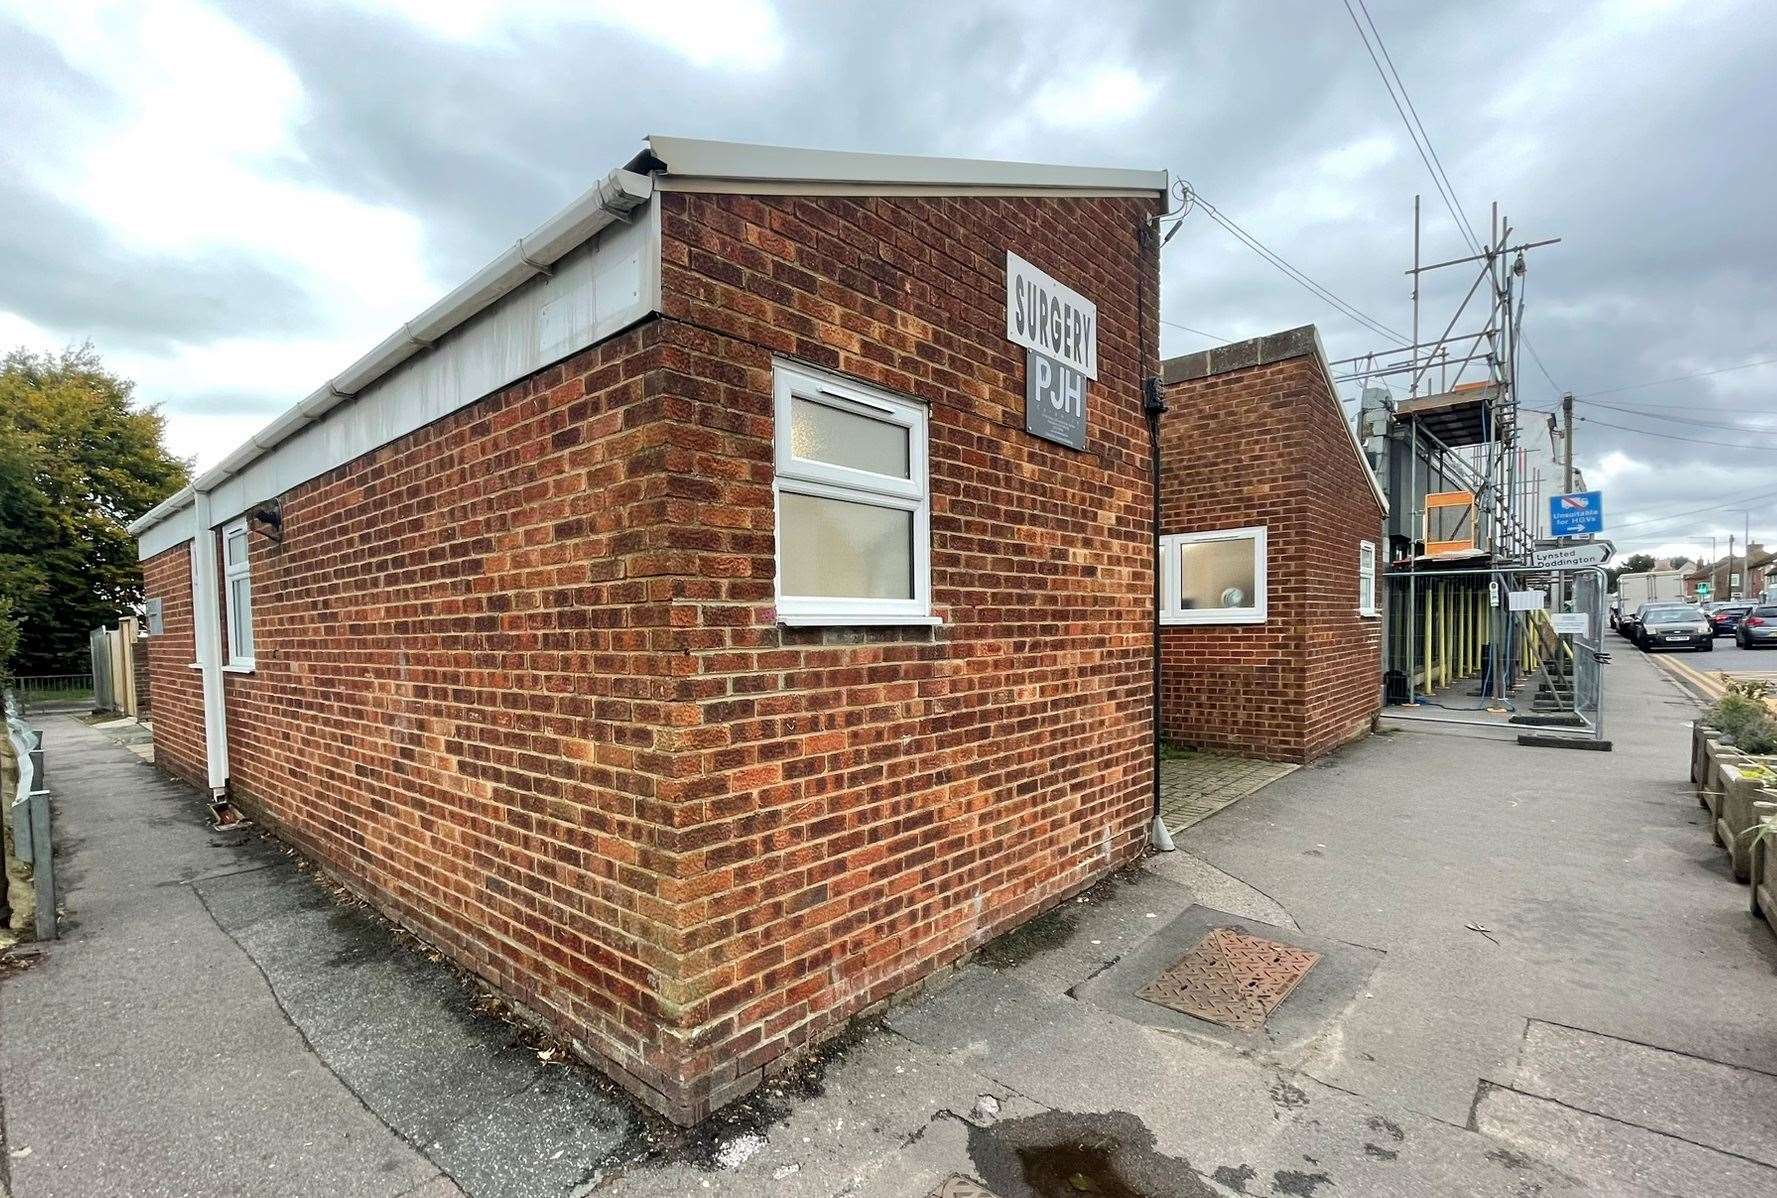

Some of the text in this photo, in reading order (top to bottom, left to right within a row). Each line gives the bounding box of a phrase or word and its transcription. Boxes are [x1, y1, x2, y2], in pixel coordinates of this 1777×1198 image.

[1015, 273, 1091, 368] SURGERY
[1035, 355, 1081, 418] PJH
[1553, 509, 1599, 519] Unsuitable
[1572, 516, 1596, 524] HGVs
[1536, 550, 1576, 561] Lynsted
[1537, 557, 1596, 568] Doddington
